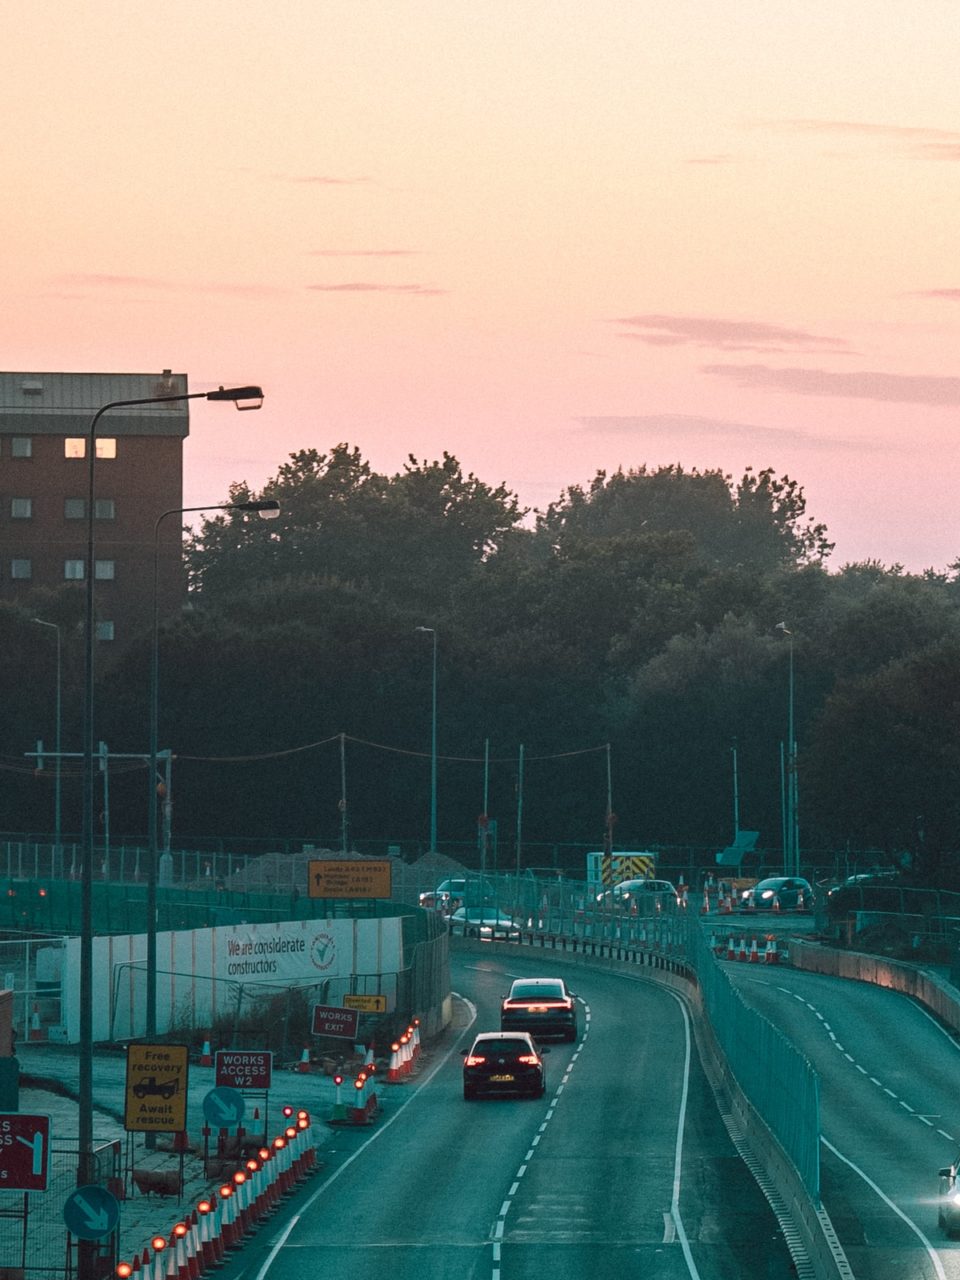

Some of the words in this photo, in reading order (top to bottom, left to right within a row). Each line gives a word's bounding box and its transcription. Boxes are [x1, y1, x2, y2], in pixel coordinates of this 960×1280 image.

[227, 939, 240, 957] We
[241, 943, 253, 956] are
[254, 937, 305, 954] considerate
[227, 960, 277, 976] constructors
[320, 1011, 353, 1022] WORKS
[325, 1022, 345, 1032] EXIT
[144, 1051, 171, 1061] Free
[223, 1055, 264, 1065] WORKS
[132, 1062, 183, 1074] recovery
[220, 1066, 266, 1076] ACCESS
[139, 1103, 172, 1114] Await
[135, 1115, 175, 1125] rescue
